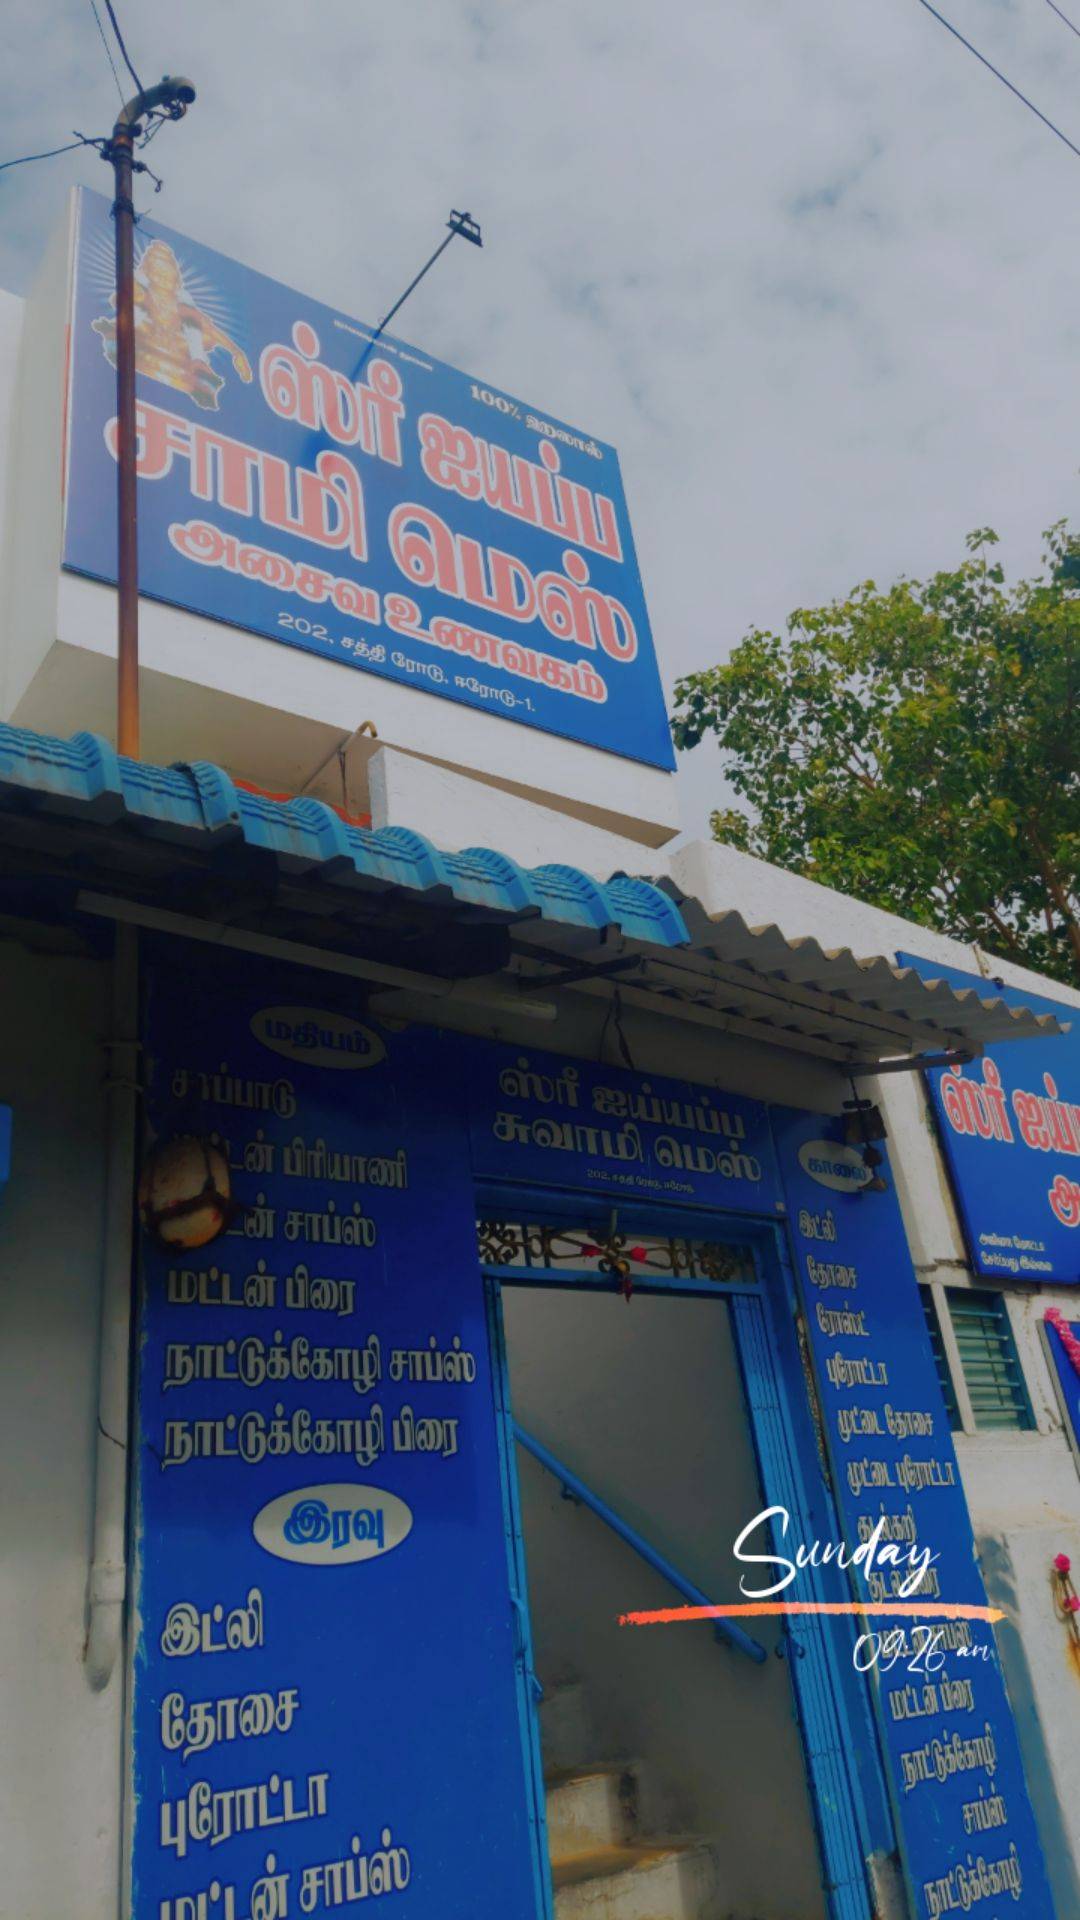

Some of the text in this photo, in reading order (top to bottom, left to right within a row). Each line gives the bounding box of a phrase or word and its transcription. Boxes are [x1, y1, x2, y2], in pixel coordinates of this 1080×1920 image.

[417, 411, 625, 564] ஐயப்ப
[104, 398, 638, 663] சாமி மெஸ்
[167, 519, 608, 704] அசைவ உணவகம்
[282, 1135, 409, 1190] பிரியாணி
[492, 1110, 763, 1182] சுவாமி மெஸ்
[284, 1199, 377, 1248] சாப்ஸ்
[167, 1258, 356, 1317] மட்டன் பிரை
[806, 1254, 859, 1290] தோசை
[162, 1329, 477, 1394] நாட்டுக்கோழி சாப்ஸ்
[825, 1350, 889, 1390] புரோட்டா
[161, 1401, 459, 1472] நாட்டுக்கோழி பிரை
[837, 1403, 934, 1443] முட்டை தோசை
[847, 1456, 896, 1497] முட்டை
[283, 1499, 386, 1549] இரவு
[161, 1587, 265, 1657] இட்லி
[161, 1688, 300, 1765] தோசை
[888, 1673, 940, 1721] மட்டன்
[160, 1772, 330, 1858] புரோட்டா
[300, 1827, 411, 1913] சாப்ஸ்
